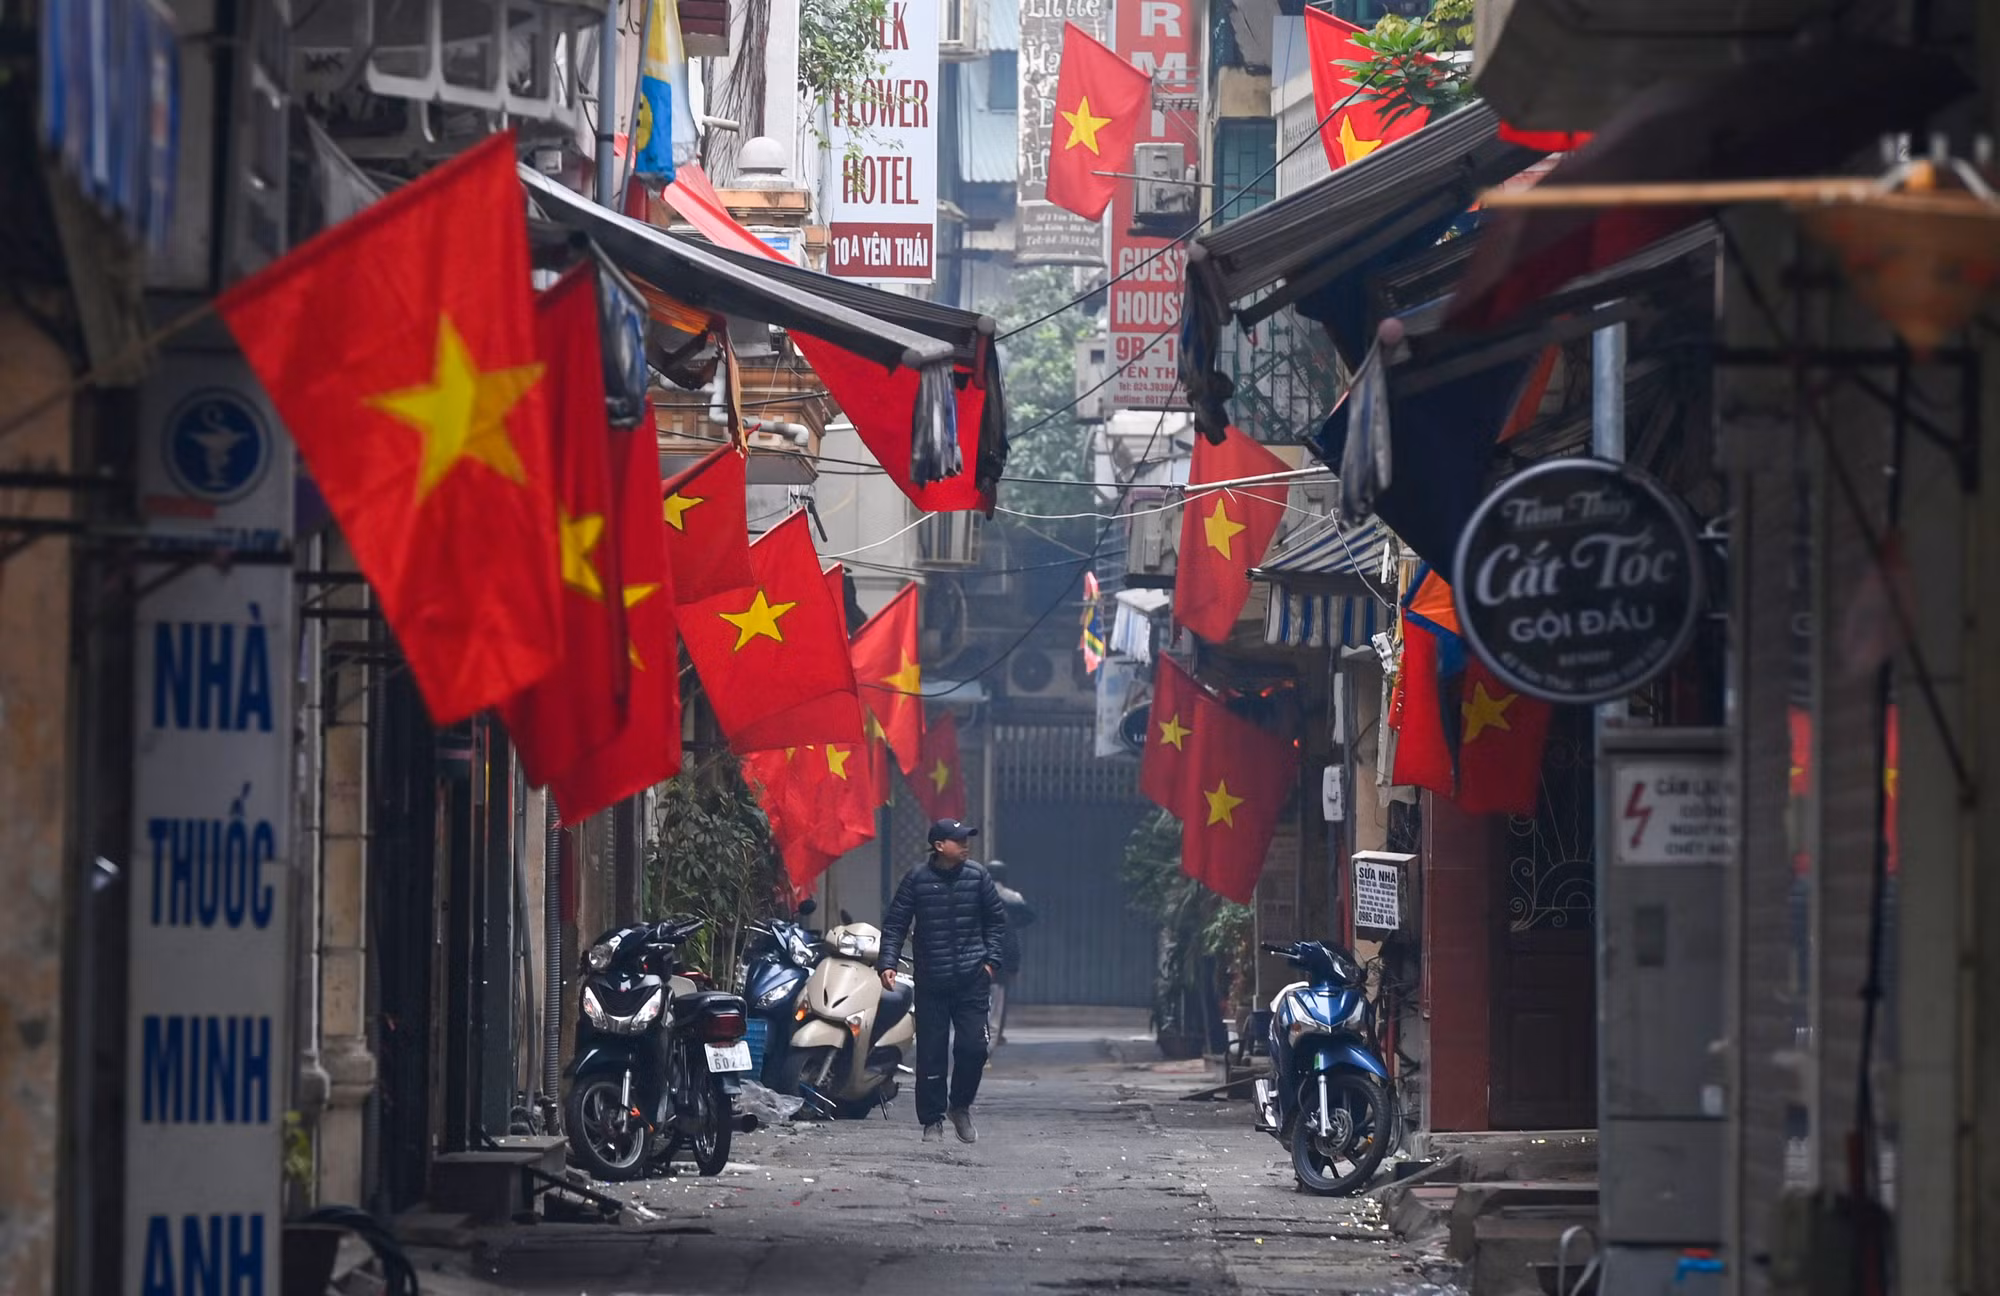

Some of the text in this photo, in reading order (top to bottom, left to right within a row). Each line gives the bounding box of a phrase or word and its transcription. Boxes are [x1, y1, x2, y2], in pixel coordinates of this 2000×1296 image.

[833, 79, 929, 128] FLOWER
[842, 155, 919, 205] HOTEL
[862, 231, 892, 267] YÊN
[895, 232, 929, 267] THÁI
[1116, 290, 1184, 326] HOUS
[1115, 336, 1145, 362] 9B
[1116, 362, 1149, 379] YÊN
[1476, 524, 1676, 605] Cắt Tóc
[152, 603, 274, 733] NHÀ
[149, 782, 275, 928] THUỐC
[1359, 863, 1397, 884] SỬA NHÀ
[141, 1015, 271, 1124] MINH
[139, 1213, 264, 1296] ANH
